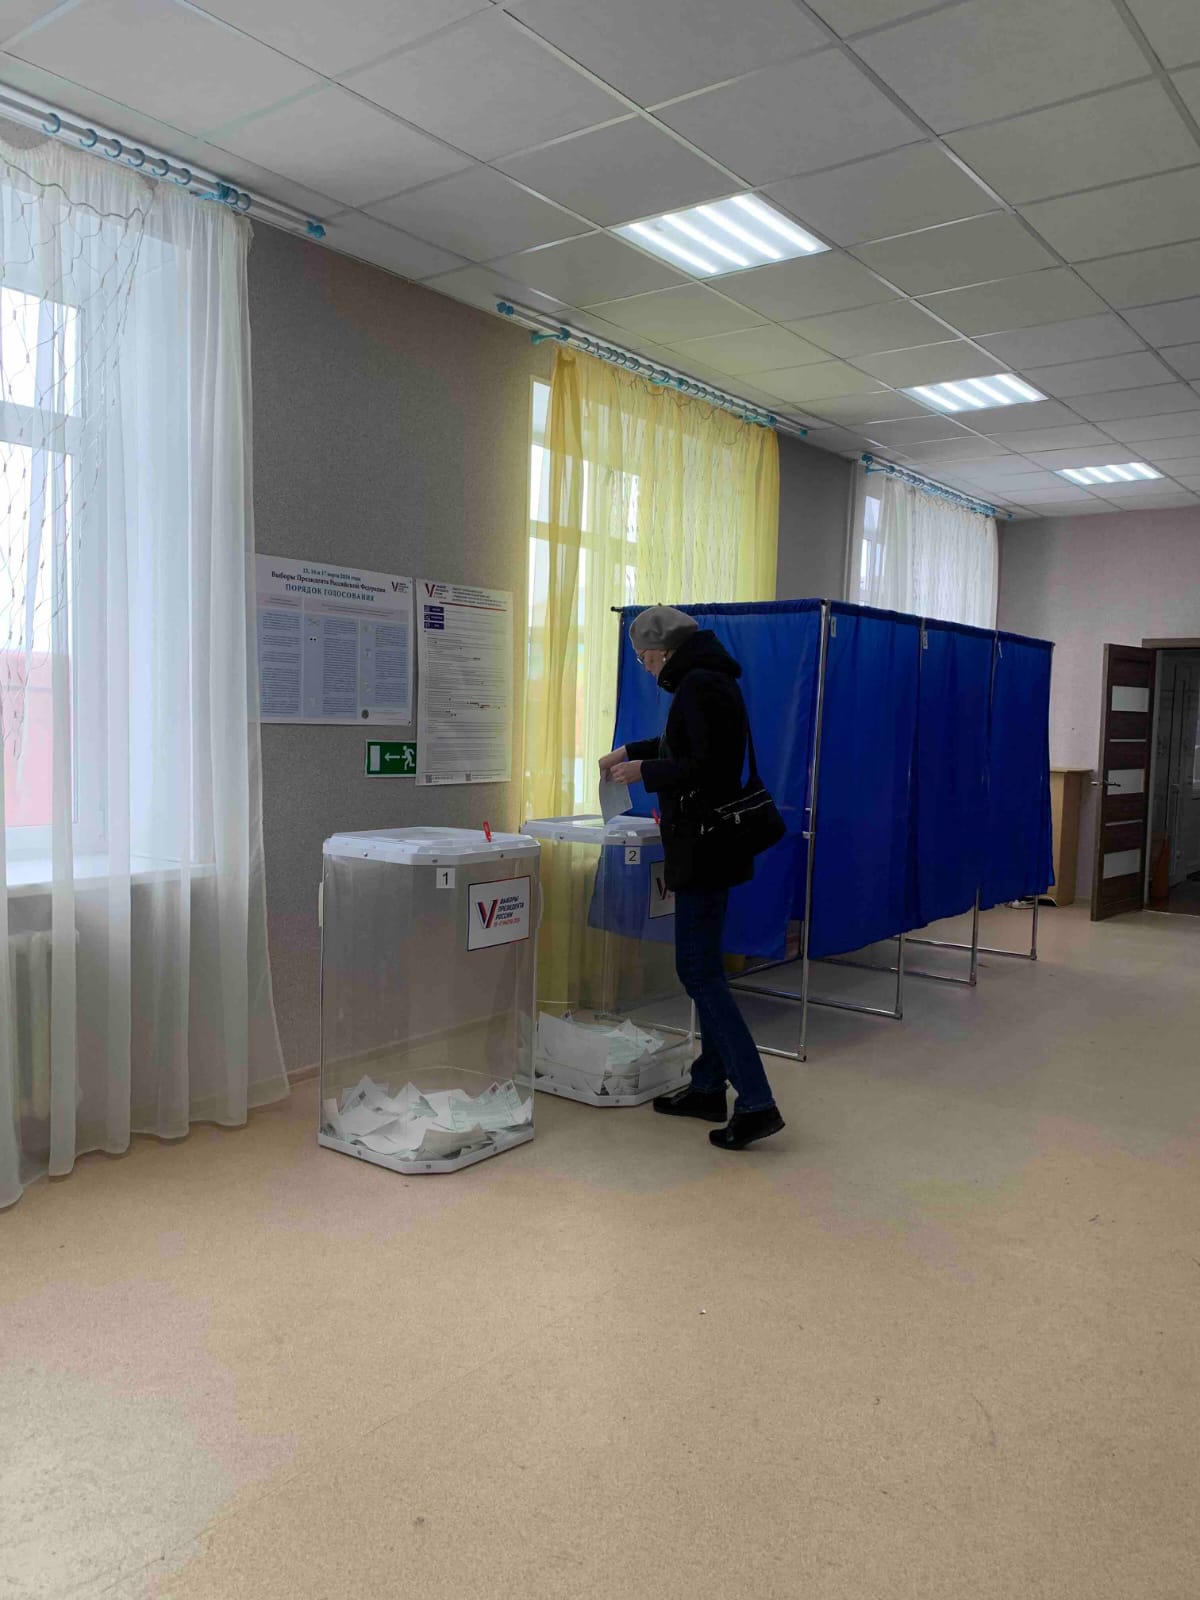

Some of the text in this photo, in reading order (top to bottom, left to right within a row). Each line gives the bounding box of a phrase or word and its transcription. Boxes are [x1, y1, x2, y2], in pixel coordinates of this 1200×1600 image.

[271, 571, 386, 593] Выборы Президента Российской Федерации
[285, 583, 375, 601] ПОРЯДОК ГОЛОСОВАНИЯ
[628, 850, 637, 862] 2
[442, 872, 448, 886] 1
